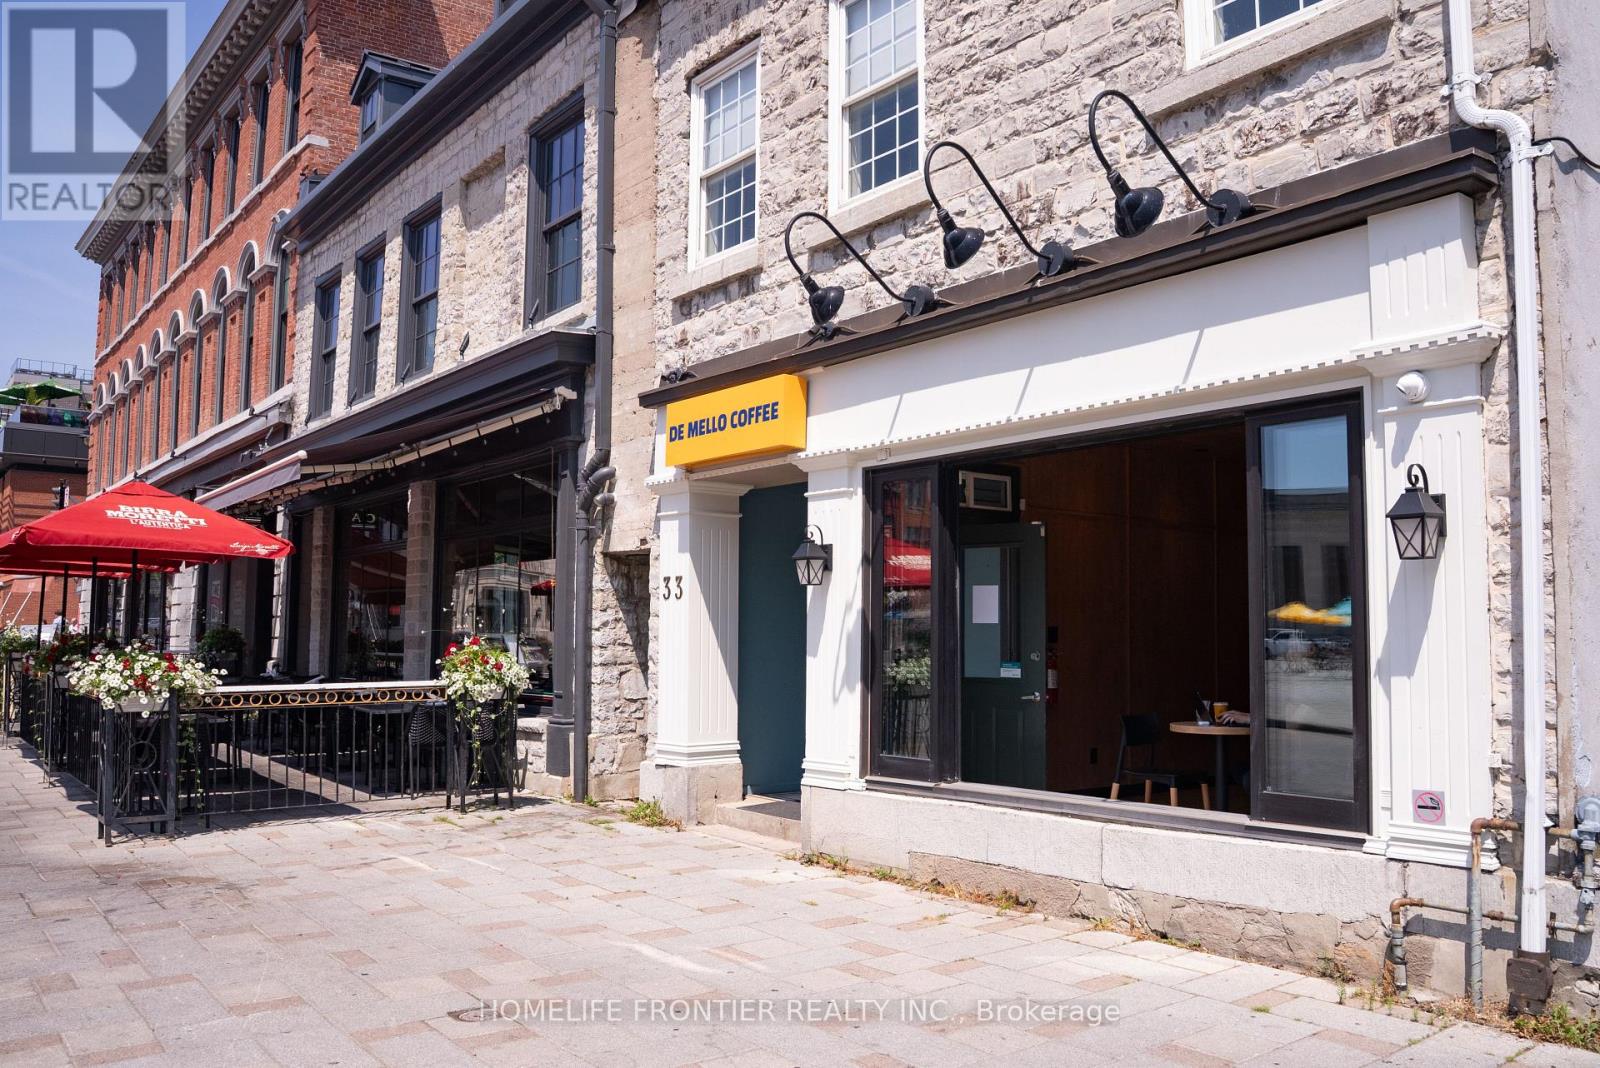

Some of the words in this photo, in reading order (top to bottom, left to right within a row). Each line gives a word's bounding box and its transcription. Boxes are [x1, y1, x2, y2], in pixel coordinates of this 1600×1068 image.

[669, 423, 685, 442] DE
[687, 413, 727, 438] MELLO
[730, 401, 779, 428] COFFEE
[104, 509, 208, 527] MORETTI
[118, 504, 189, 519] BIRRA
[663, 575, 683, 600] 33
